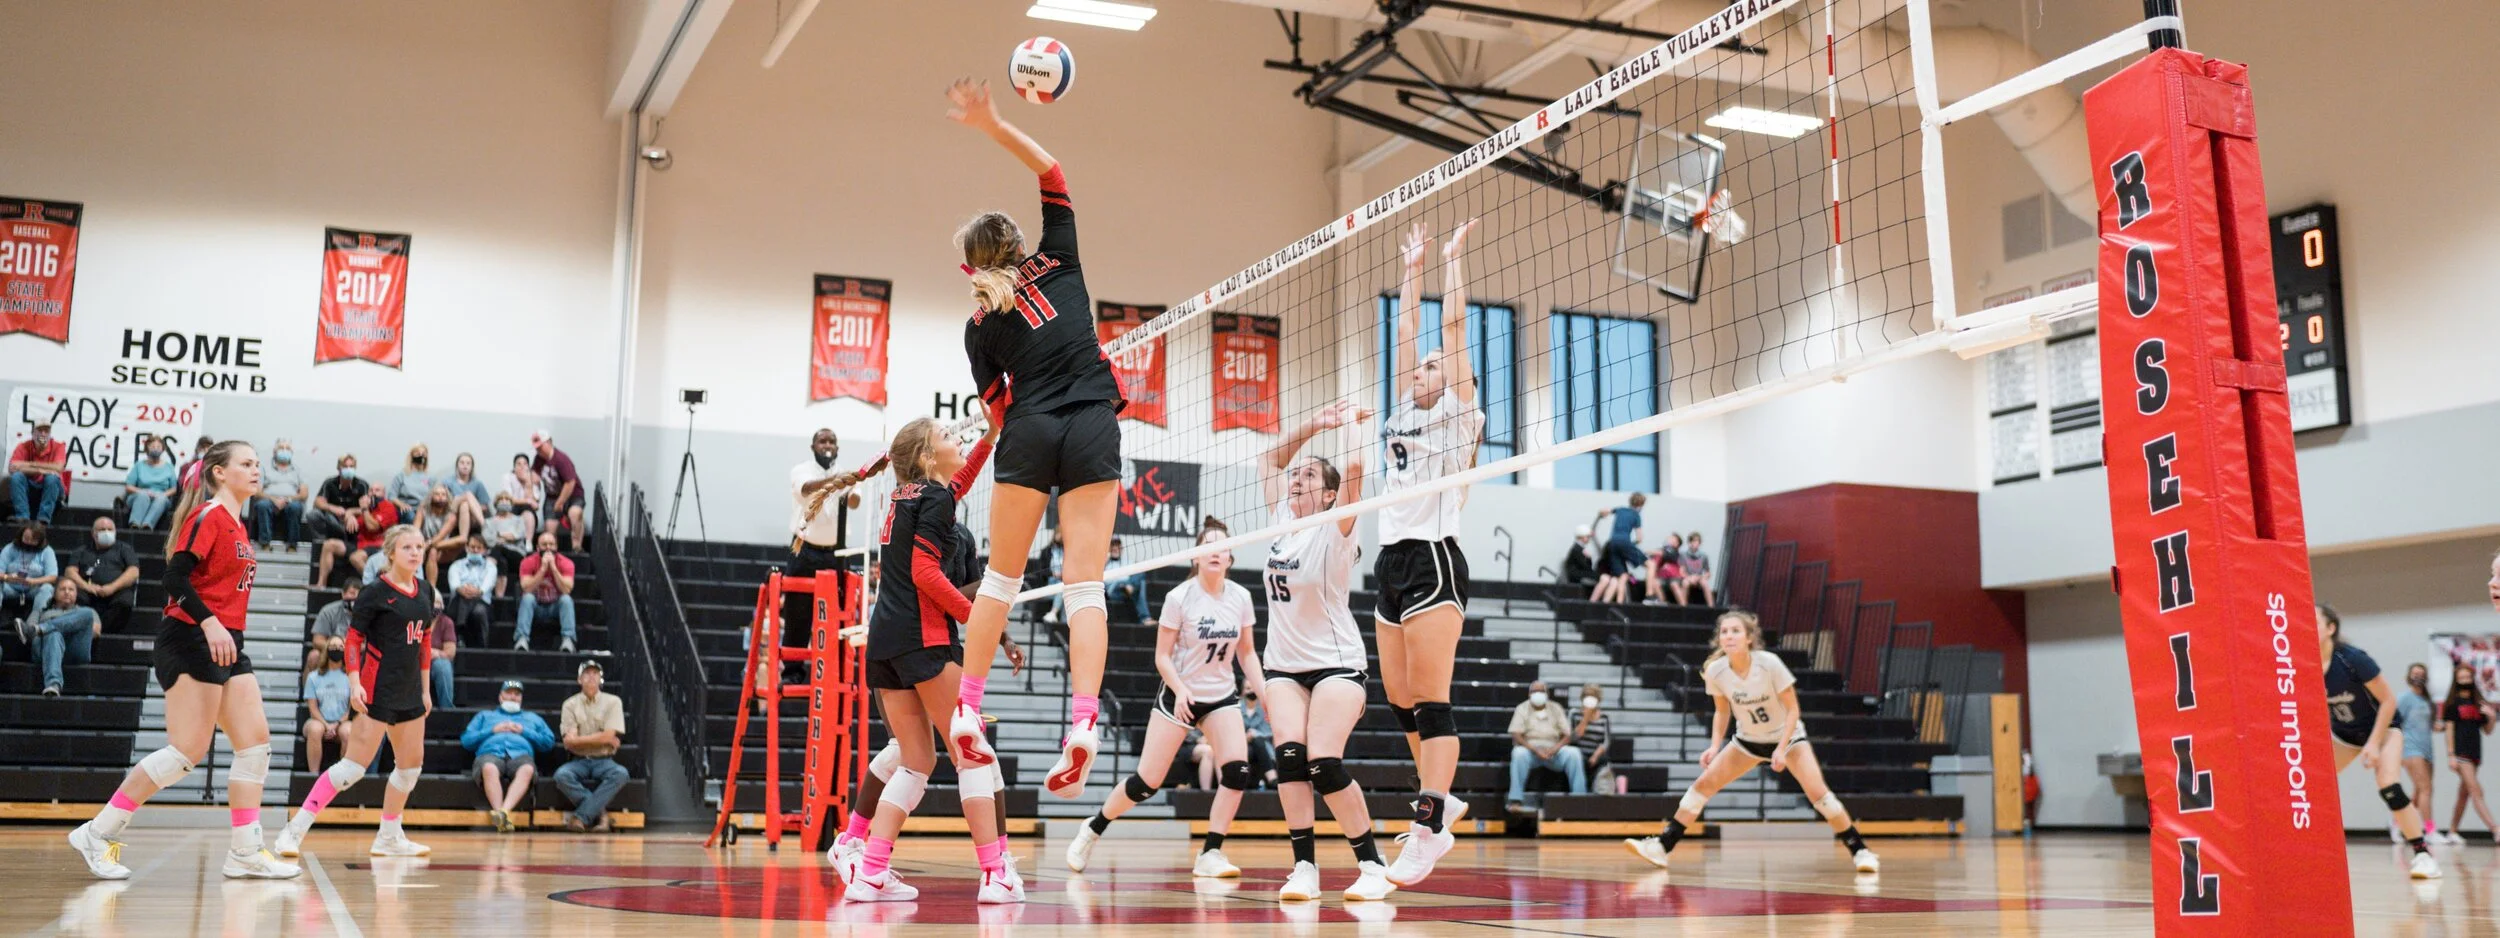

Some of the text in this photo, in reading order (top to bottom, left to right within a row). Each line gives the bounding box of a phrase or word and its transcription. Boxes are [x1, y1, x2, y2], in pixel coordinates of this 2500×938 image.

[1017, 63, 1050, 78] Wilson
[1565, 0, 1780, 116] LADY EAGLE VOLLEYBAL
[1536, 110, 1549, 130] R
[1366, 125, 1521, 220] LADY EAGLE VOLLEYBALL
[24, 201, 44, 221] R
[1346, 213, 1355, 230] R
[13, 224, 51, 239] BASEBALL
[0, 240, 59, 278] 2016
[1219, 225, 1335, 297] LADY EAGLE VOLLEYBALL
[2303, 229, 2324, 268] 0
[7, 281, 45, 298] STATE
[336, 269, 392, 306] 2017
[1204, 290, 1212, 305] R
[0, 297, 63, 317] AMPIONS
[1014, 283, 1058, 330] 11
[1127, 323, 1148, 345] EAGLE
[1150, 299, 1196, 332] VOLLEYBALL
[828, 314, 873, 347] 2011
[2307, 315, 2324, 344] 0
[121, 328, 262, 368] HOME
[111, 365, 267, 393] SECTION B
[1223, 350, 1267, 382] 2018
[22, 394, 193, 430] LADY 2020
[65, 432, 178, 472] AGLES
[1391, 442, 1408, 471] 9
[1135, 502, 1197, 536] WIN
[2111, 151, 2220, 915] ROSEHILL
[1269, 574, 1291, 602] 15
[406, 620, 423, 645] 14
[1198, 625, 1238, 639] Mavericks
[1205, 642, 1229, 664] 74
[804, 599, 827, 828] ROSEHILL
[2266, 592, 2311, 829] sports imports
